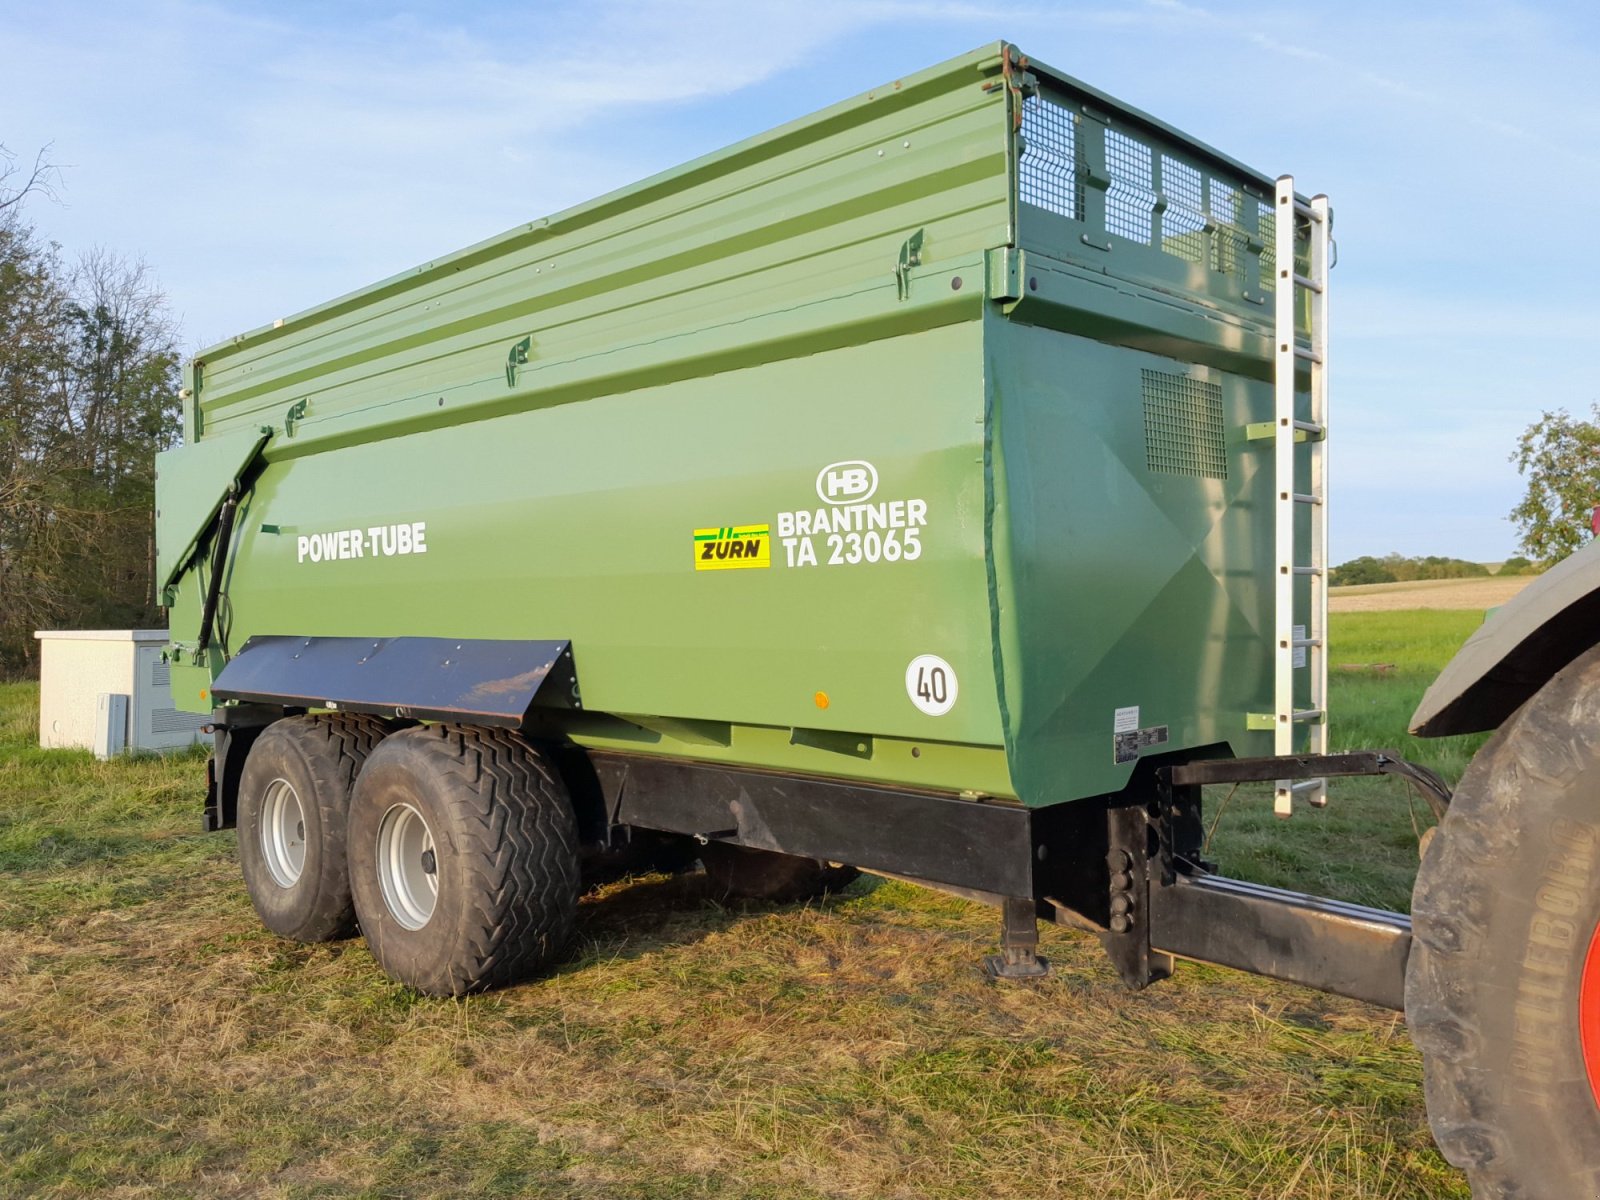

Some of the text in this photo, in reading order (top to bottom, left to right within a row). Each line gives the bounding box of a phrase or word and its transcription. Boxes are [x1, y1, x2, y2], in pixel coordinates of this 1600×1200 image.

[827, 468, 869, 497] HB
[777, 499, 928, 537] BRANTNER
[297, 521, 427, 563] POWER-TUBE
[782, 527, 922, 568] TA 23065
[917, 666, 947, 704] 40
[1502, 816, 1597, 1107] TRELLEBORG
